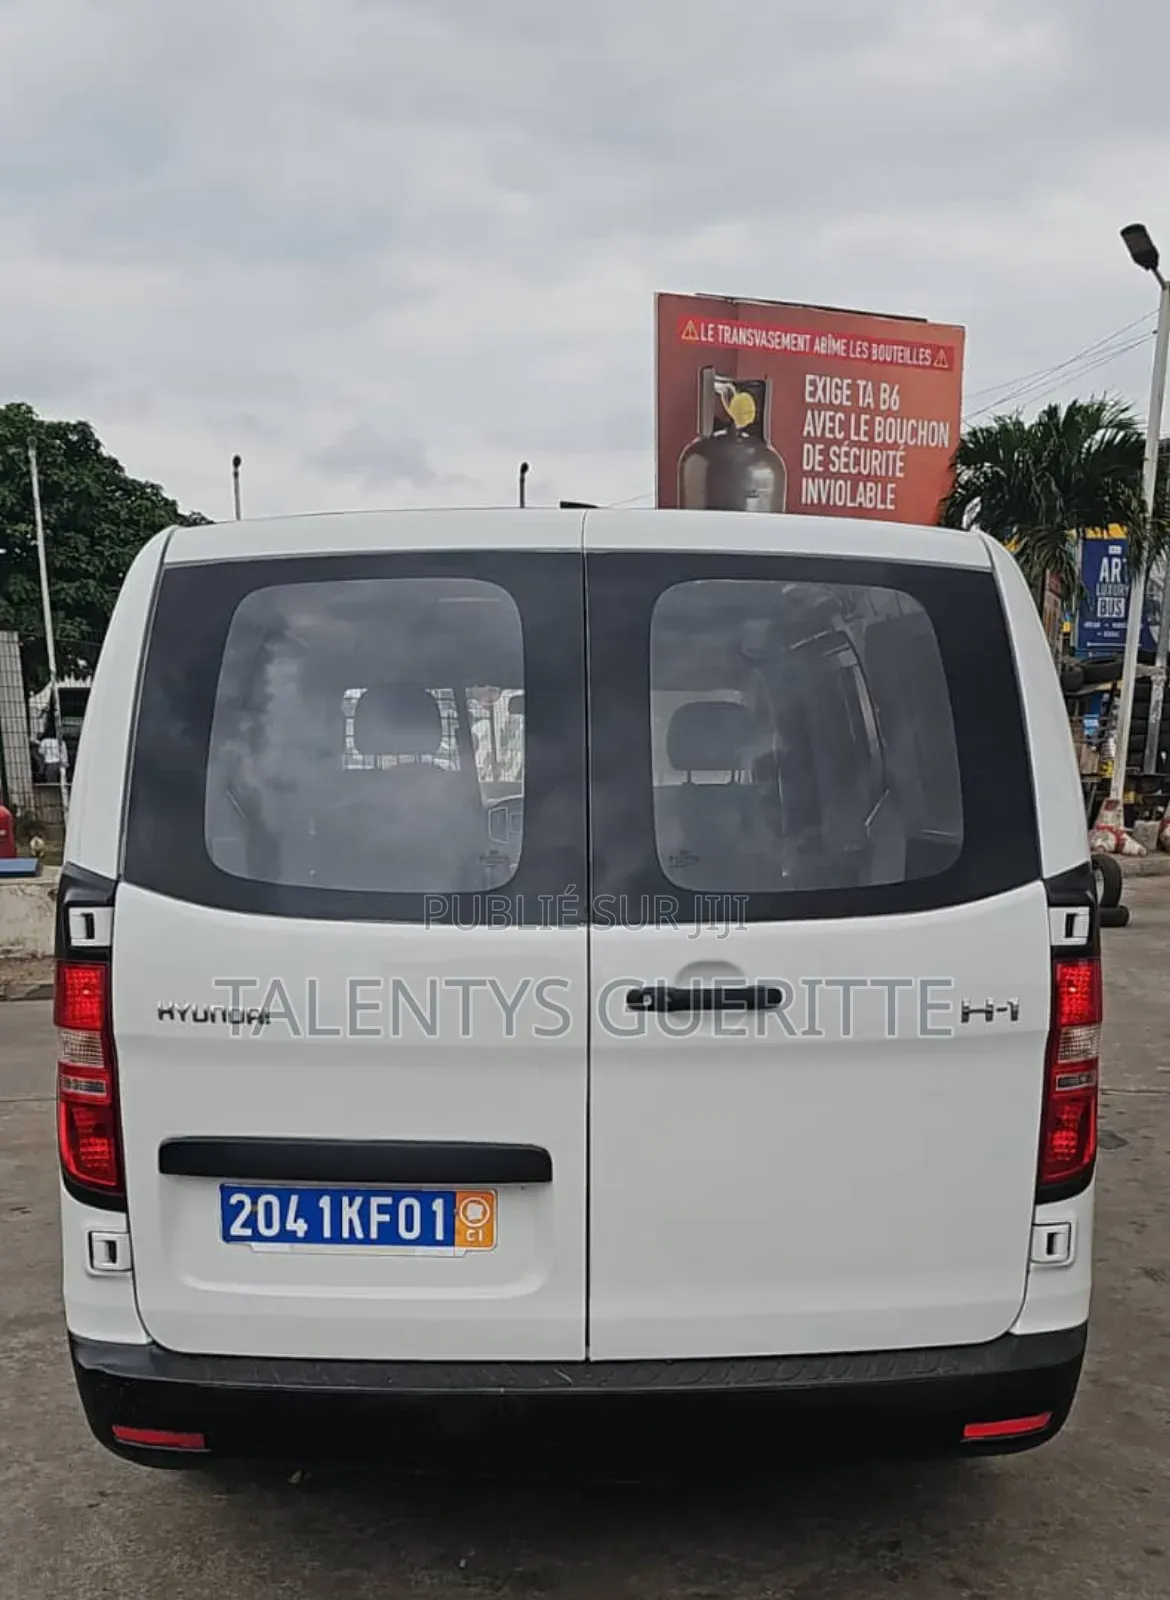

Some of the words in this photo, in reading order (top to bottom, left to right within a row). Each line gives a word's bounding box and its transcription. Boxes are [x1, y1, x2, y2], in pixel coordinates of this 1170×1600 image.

[700, 322, 713, 343] LE
[716, 324, 811, 353] TRANSVASEMENT
[813, 333, 847, 356] ABÎME
[849, 340, 869, 359] LES
[871, 343, 932, 366] BOUTEILLES
[805, 374, 852, 406] EXIGE
[857, 379, 876, 407] TA
[879, 382, 900, 410] B6
[803, 410, 846, 439] AVEC
[851, 415, 869, 442] LE
[874, 417, 950, 448] BOUCHON
[802, 443, 824, 472] DE
[831, 439, 906, 478] SÉCURITÉ
[801, 477, 897, 510] INVIOLABLE
[156, 1002, 272, 1026] HYUNDAI
[960, 997, 1019, 1023] H-1
